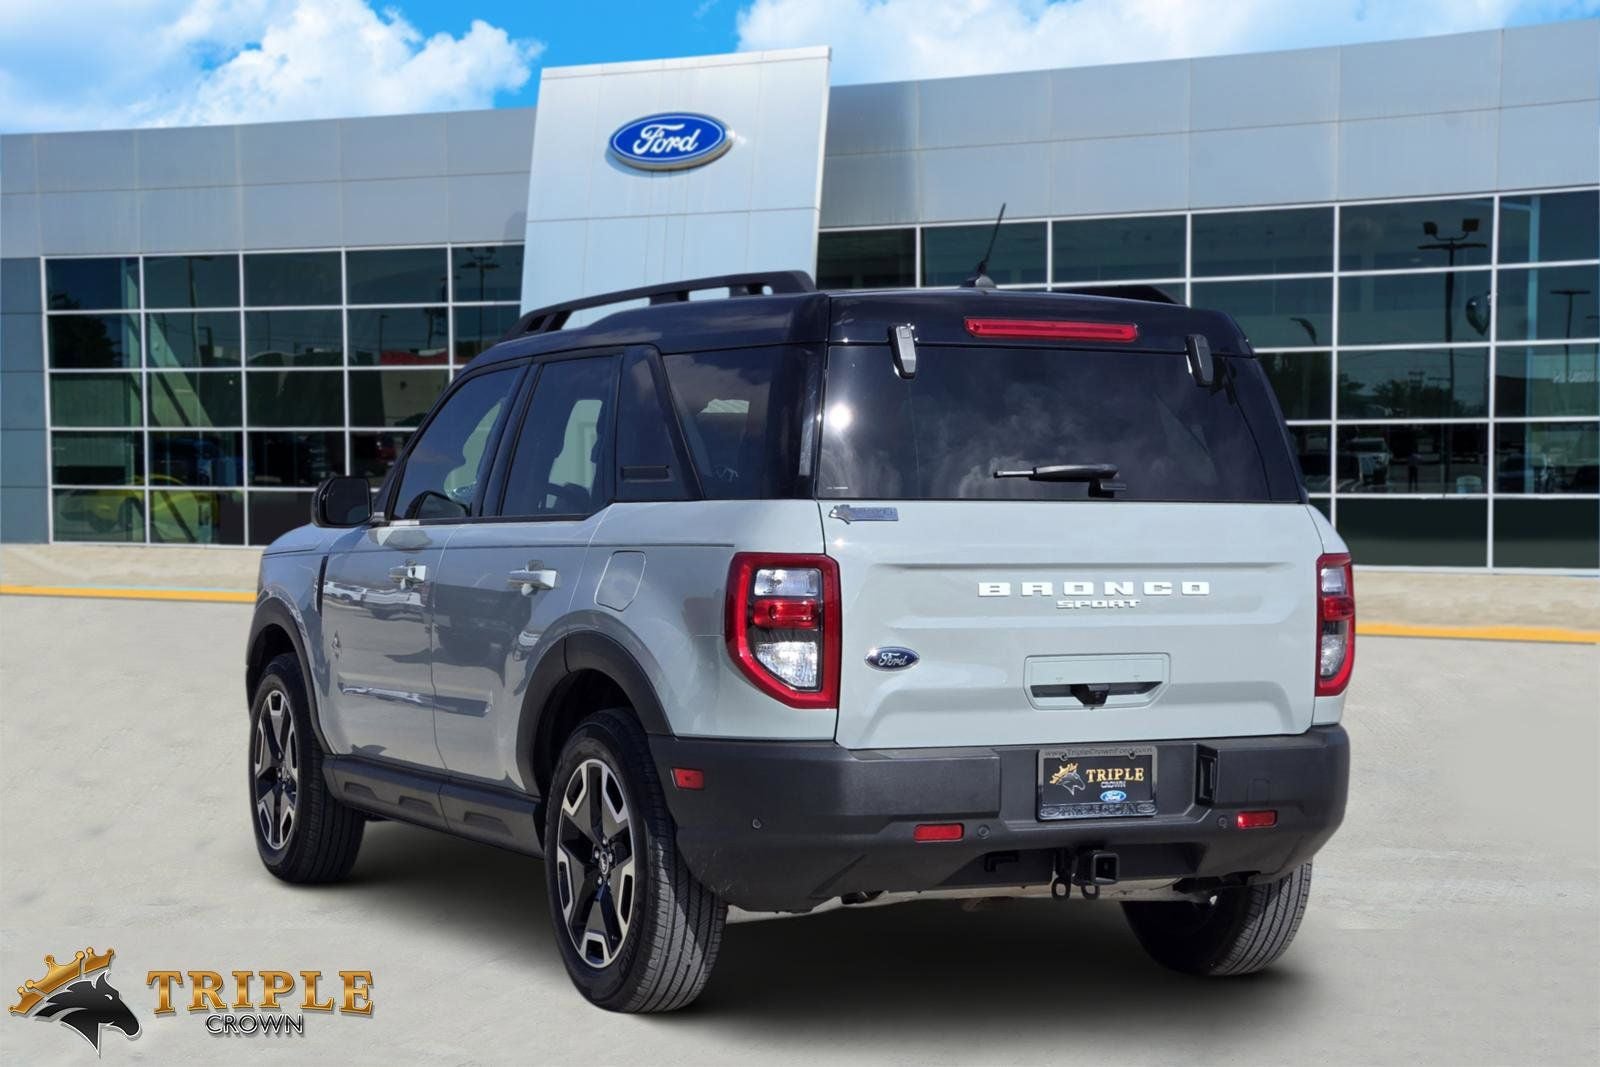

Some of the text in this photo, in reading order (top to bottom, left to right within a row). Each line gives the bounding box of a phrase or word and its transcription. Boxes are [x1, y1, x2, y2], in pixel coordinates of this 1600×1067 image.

[632, 123, 702, 154] Ford
[978, 581, 1211, 597] BRONCO
[1056, 599, 1141, 609] SPORT
[879, 652, 908, 666] Ford
[1085, 767, 1145, 783] TRIPLE
